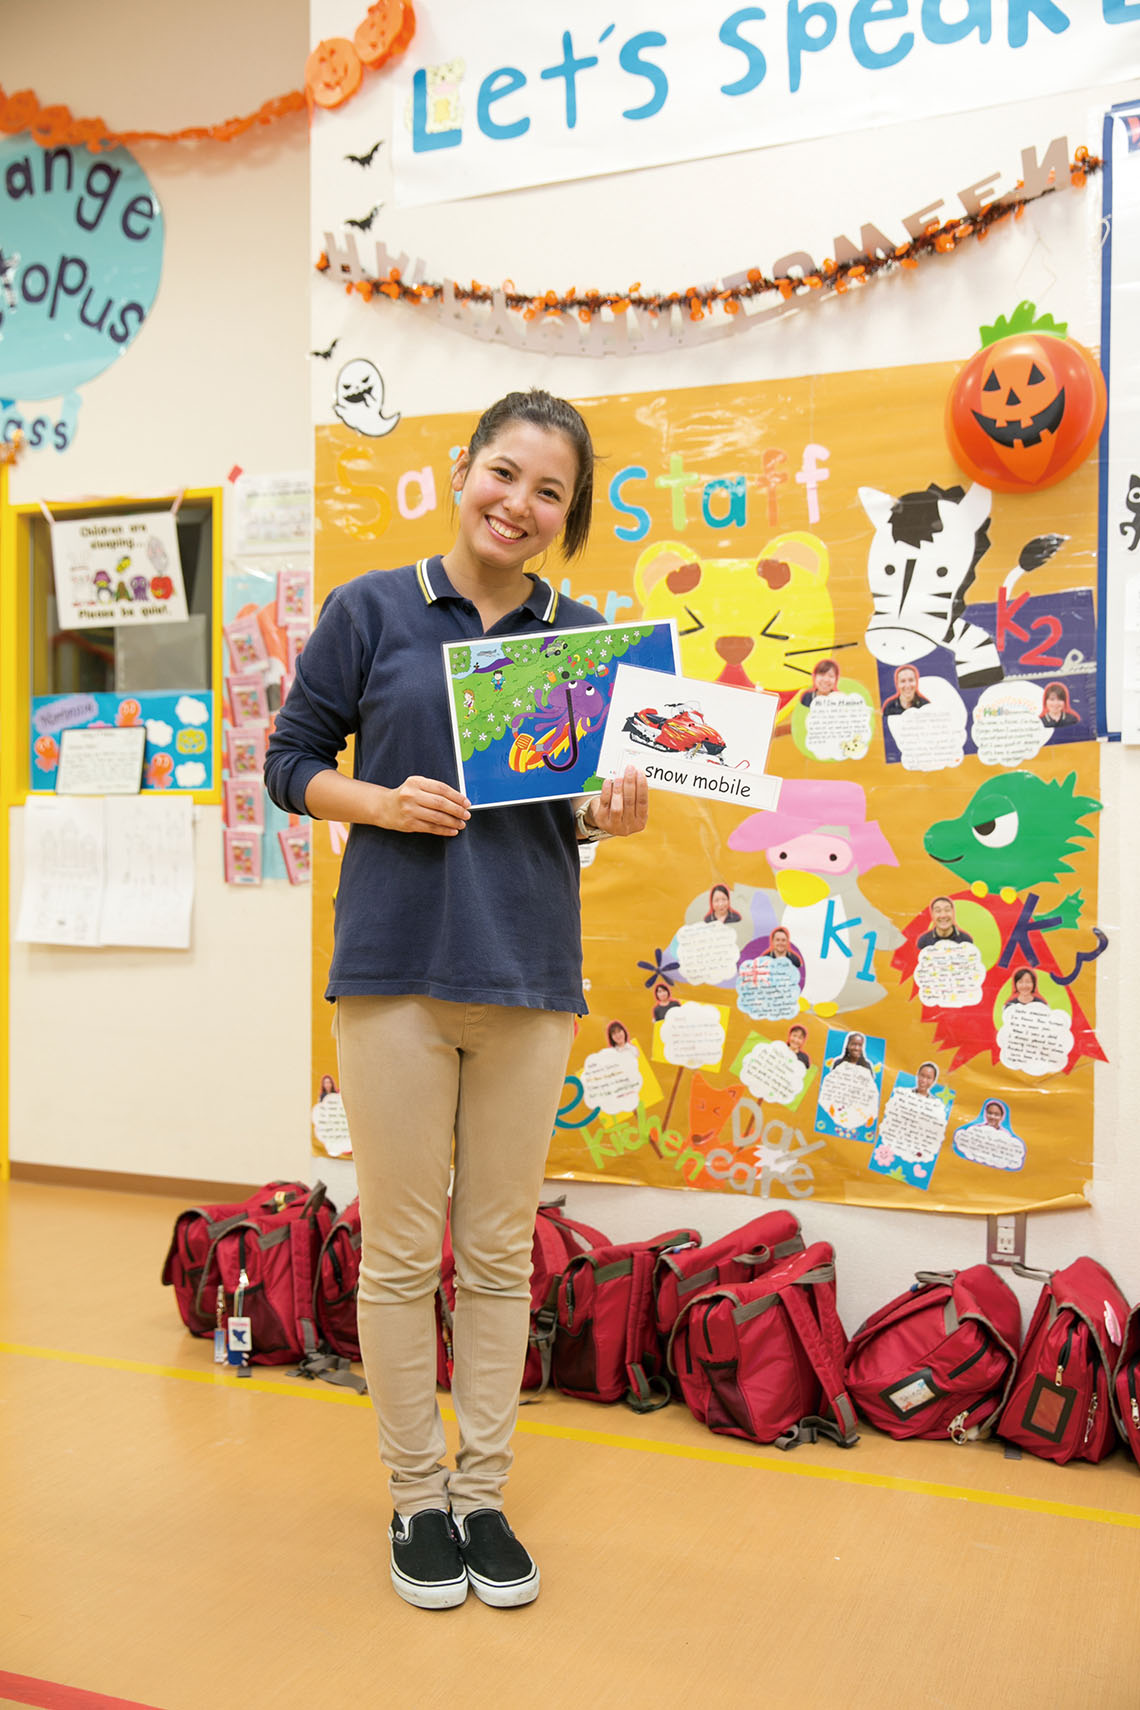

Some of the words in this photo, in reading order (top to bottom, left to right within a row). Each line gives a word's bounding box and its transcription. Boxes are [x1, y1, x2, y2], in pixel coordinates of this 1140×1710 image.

[412, 23, 668, 154] Let's
[718, 0, 1071, 97] speak
[608, 443, 831, 542] Staff
[80, 525, 122, 537] Children
[130, 523, 147, 532] are
[79, 608, 114, 619] Please
[121, 606, 134, 616] be
[995, 586, 1063, 667] K2
[645, 765, 688, 785] snow
[692, 774, 751, 798] mobile
[731, 1097, 827, 1164] Day
[705, 1148, 815, 1200] care
